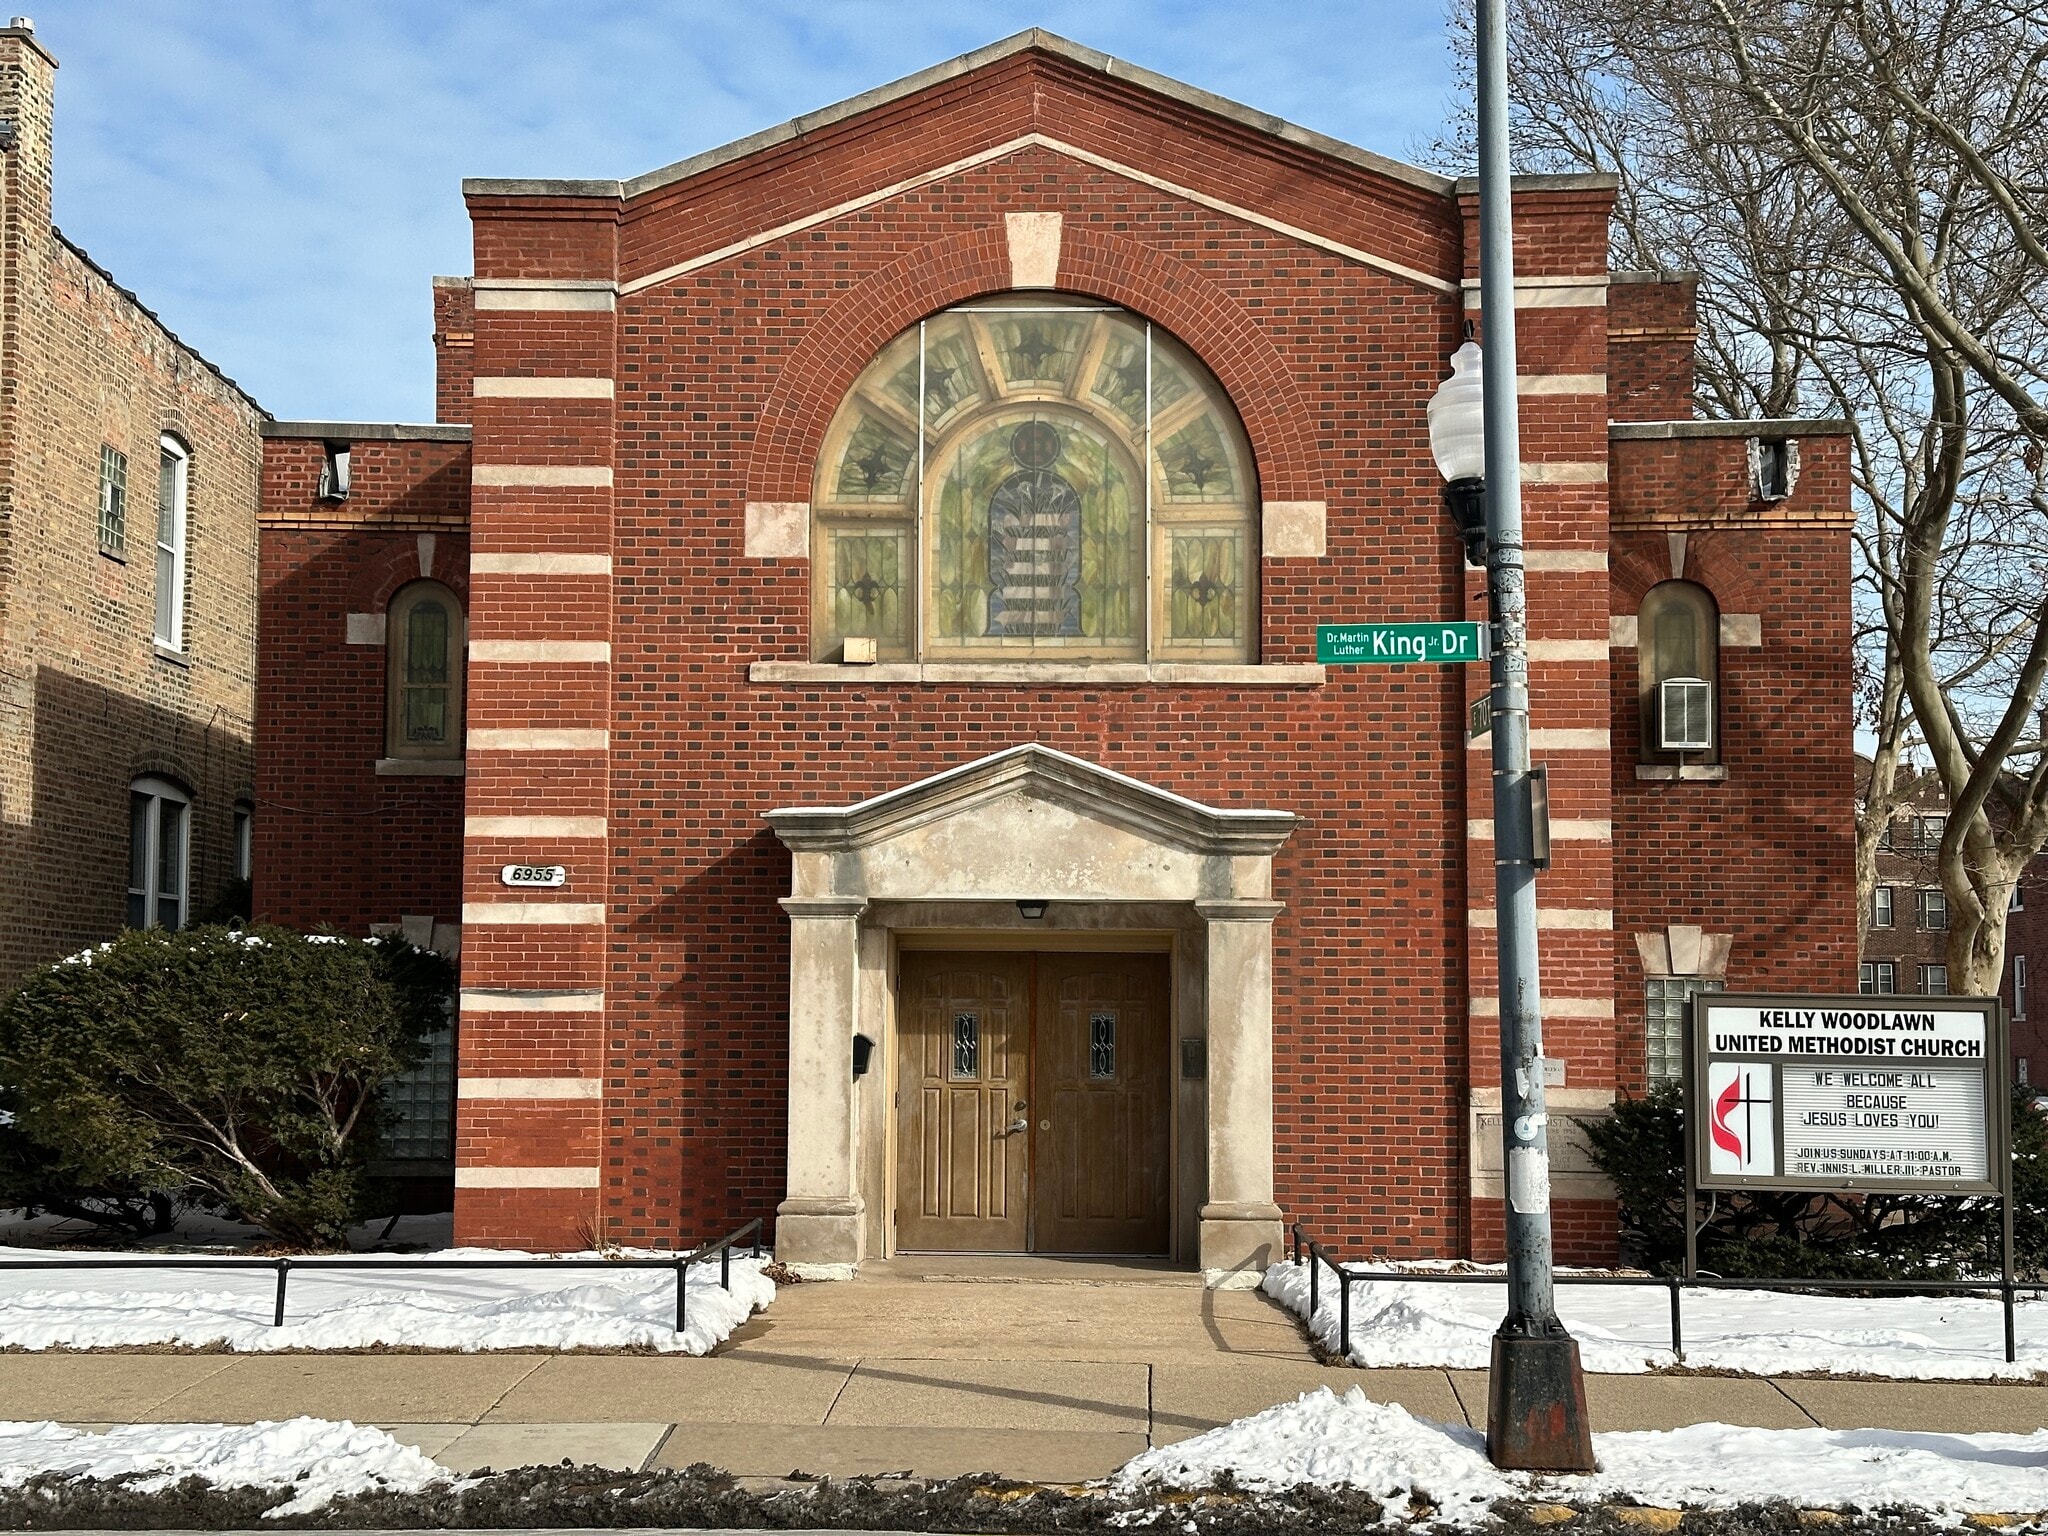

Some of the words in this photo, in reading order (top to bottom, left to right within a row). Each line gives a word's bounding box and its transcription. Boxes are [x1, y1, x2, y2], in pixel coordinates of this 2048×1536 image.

[1333, 645, 1364, 655] Luther
[1373, 630, 1426, 662] King
[1428, 636, 1440, 646] Jr.
[1442, 629, 1468, 654] Dr
[512, 868, 555, 881] 6955
[1759, 1010, 1816, 1029] KELLY
[1821, 1012, 1935, 1031] WOODLAWN
[1716, 1034, 1782, 1053] UNITED
[1788, 1036, 1896, 1055] METHODIST
[1901, 1038, 1980, 1057] CHURCH
[1815, 1072, 1833, 1086] WE
[1843, 1073, 1903, 1087] WELCOME
[1910, 1074, 1936, 1088] ALL
[1846, 1095, 1907, 1109] BECAUSE
[1803, 1112, 1847, 1126] JESUS
[1855, 1113, 1898, 1127] LOVES
[1909, 1114, 1939, 1128] YOU!
[1797, 1148, 1820, 1158] JOIN
[1823, 1148, 1837, 1158] US
[1840, 1149, 1886, 1160] SUNDAYS
[1890, 1150, 1903, 1160] AT
[1907, 1150, 1930, 1161] 11:00
[1933, 1151, 1952, 1161] A.M.
[1797, 1163, 1820, 1173] REV.
[1822, 1163, 1848, 1173] INNIS
[1852, 1164, 1861, 1174] L.
[1922, 1165, 1961, 1176] PASTOR
